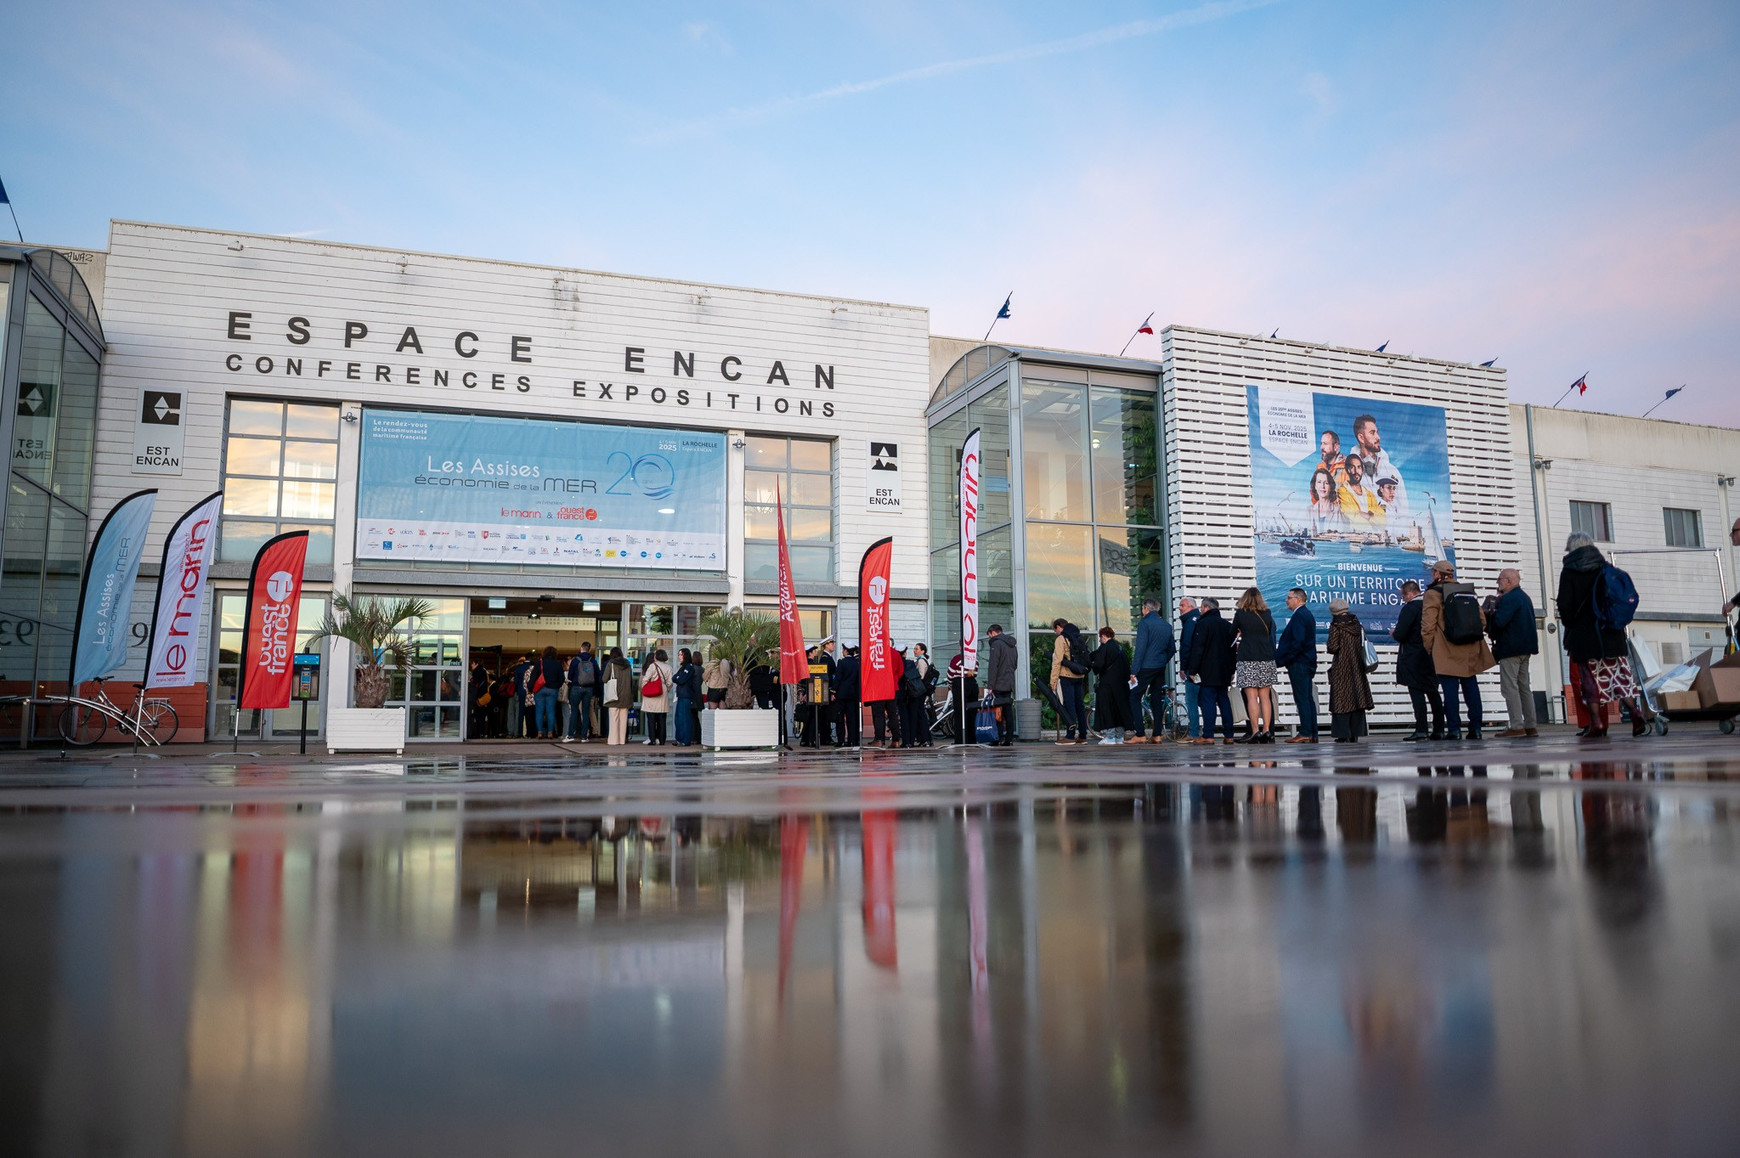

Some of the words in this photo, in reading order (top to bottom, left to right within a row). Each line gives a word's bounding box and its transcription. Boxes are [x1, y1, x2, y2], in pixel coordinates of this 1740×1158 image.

[227, 311, 532, 363] ESPACE
[624, 346, 835, 390] ENCAN
[225, 354, 531, 393] CONFERENCES
[573, 380, 835, 418] EXPOSITIONS
[383, 420, 428, 428] rendez-vous
[387, 427, 428, 435] communauté
[1277, 430, 1308, 439] ROCHELLE
[146, 446, 171, 456] EST
[658, 443, 677, 452] 2025
[136, 456, 179, 467] ENCAN
[427, 455, 464, 474] Les
[470, 457, 541, 478] Assises
[414, 474, 510, 489] économie
[513, 483, 527, 491] de
[530, 483, 540, 491] la
[543, 477, 597, 494] MER
[876, 488, 893, 497] EST
[869, 496, 900, 506] ENCAN
[501, 507, 509, 517] le
[510, 508, 542, 519] marin
[546, 511, 553, 520] &
[556, 511, 585, 520] france
[560, 506, 585, 515] ouest
[115, 537, 131, 572] MER
[1337, 562, 1383, 572] BIENVENUE
[168, 519, 210, 636] marin
[1295, 574, 1322, 587] SUR
[1327, 575, 1346, 588] UN
[1351, 576, 1425, 591] TERRITOE
[97, 573, 115, 618] Assises
[1304, 589, 1365, 605] ARITIME
[92, 621, 107, 644] Les
[259, 603, 280, 666] ouest
[267, 603, 292, 676] france
[155, 644, 186, 676] le
